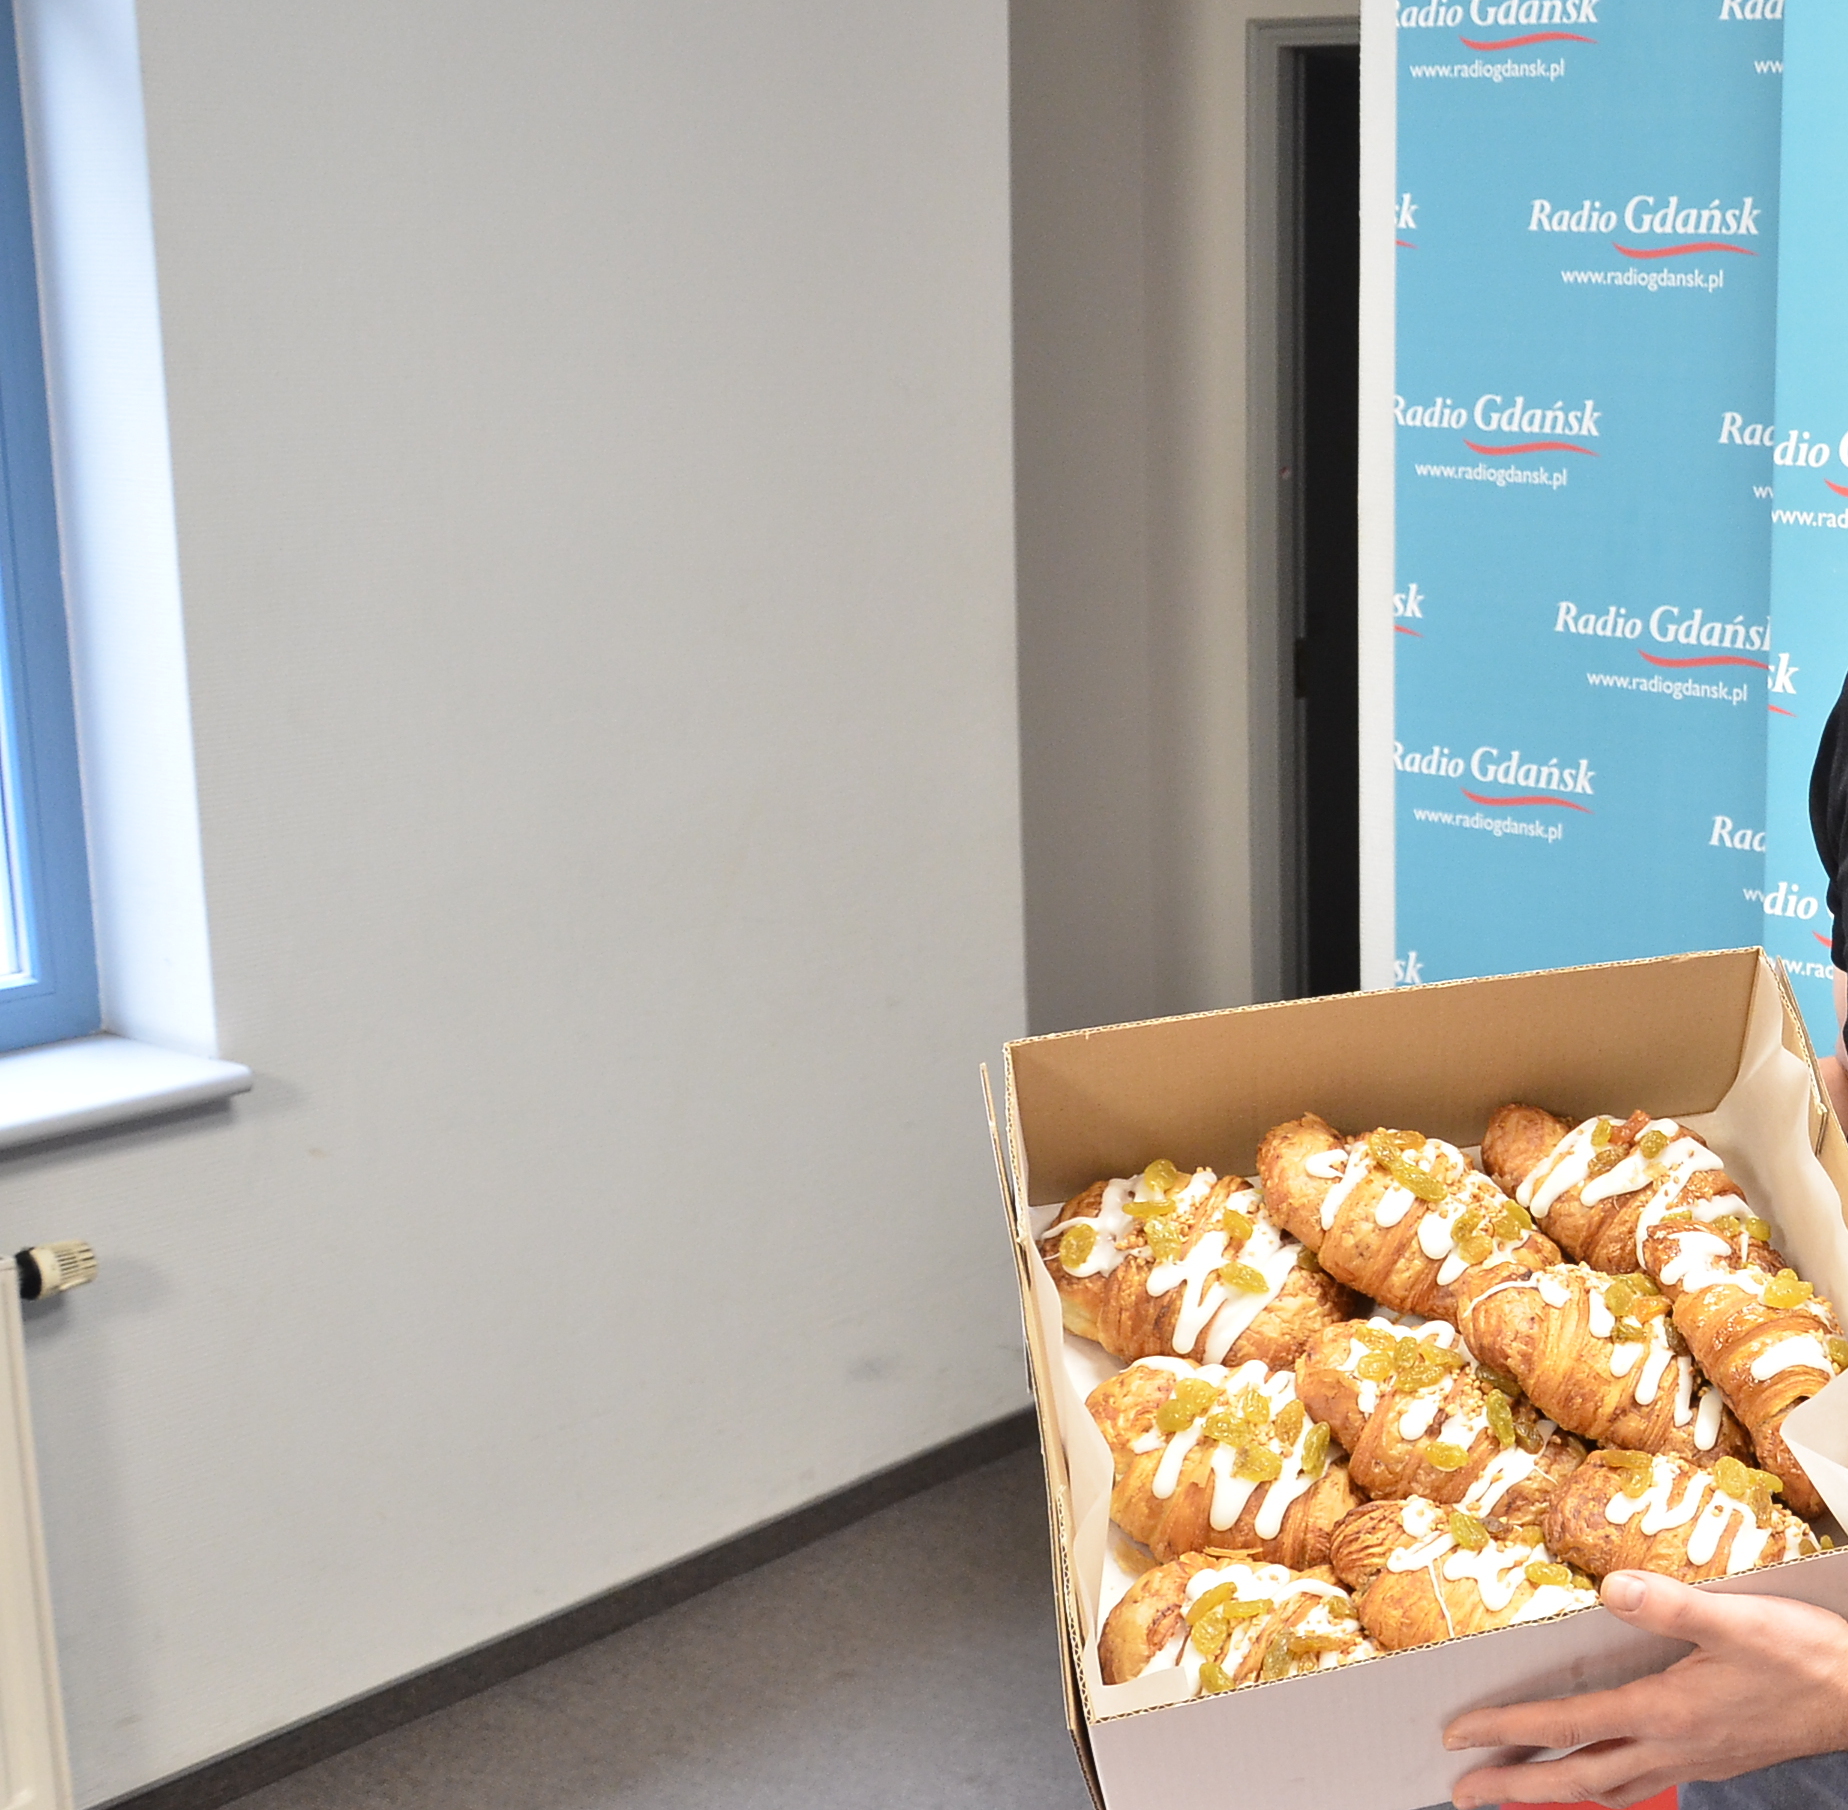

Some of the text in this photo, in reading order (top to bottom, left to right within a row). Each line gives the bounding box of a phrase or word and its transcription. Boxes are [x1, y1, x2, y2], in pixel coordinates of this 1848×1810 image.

[1410, 59, 1564, 82] www.radiogdansk.pl
[1529, 196, 1760, 234] Radio Gdańsk
[1561, 268, 1723, 292] www.radiogdansk.pl
[1474, 395, 1601, 436] Gdańsk
[1415, 463, 1567, 489] www.radiogdansk.pl
[1555, 602, 1642, 638] Radio
[1587, 674, 1747, 705] www.radiogdansk.pl
[1471, 747, 1595, 794] Gdańsk
[1414, 809, 1562, 843] www.radiogdansk.pl
